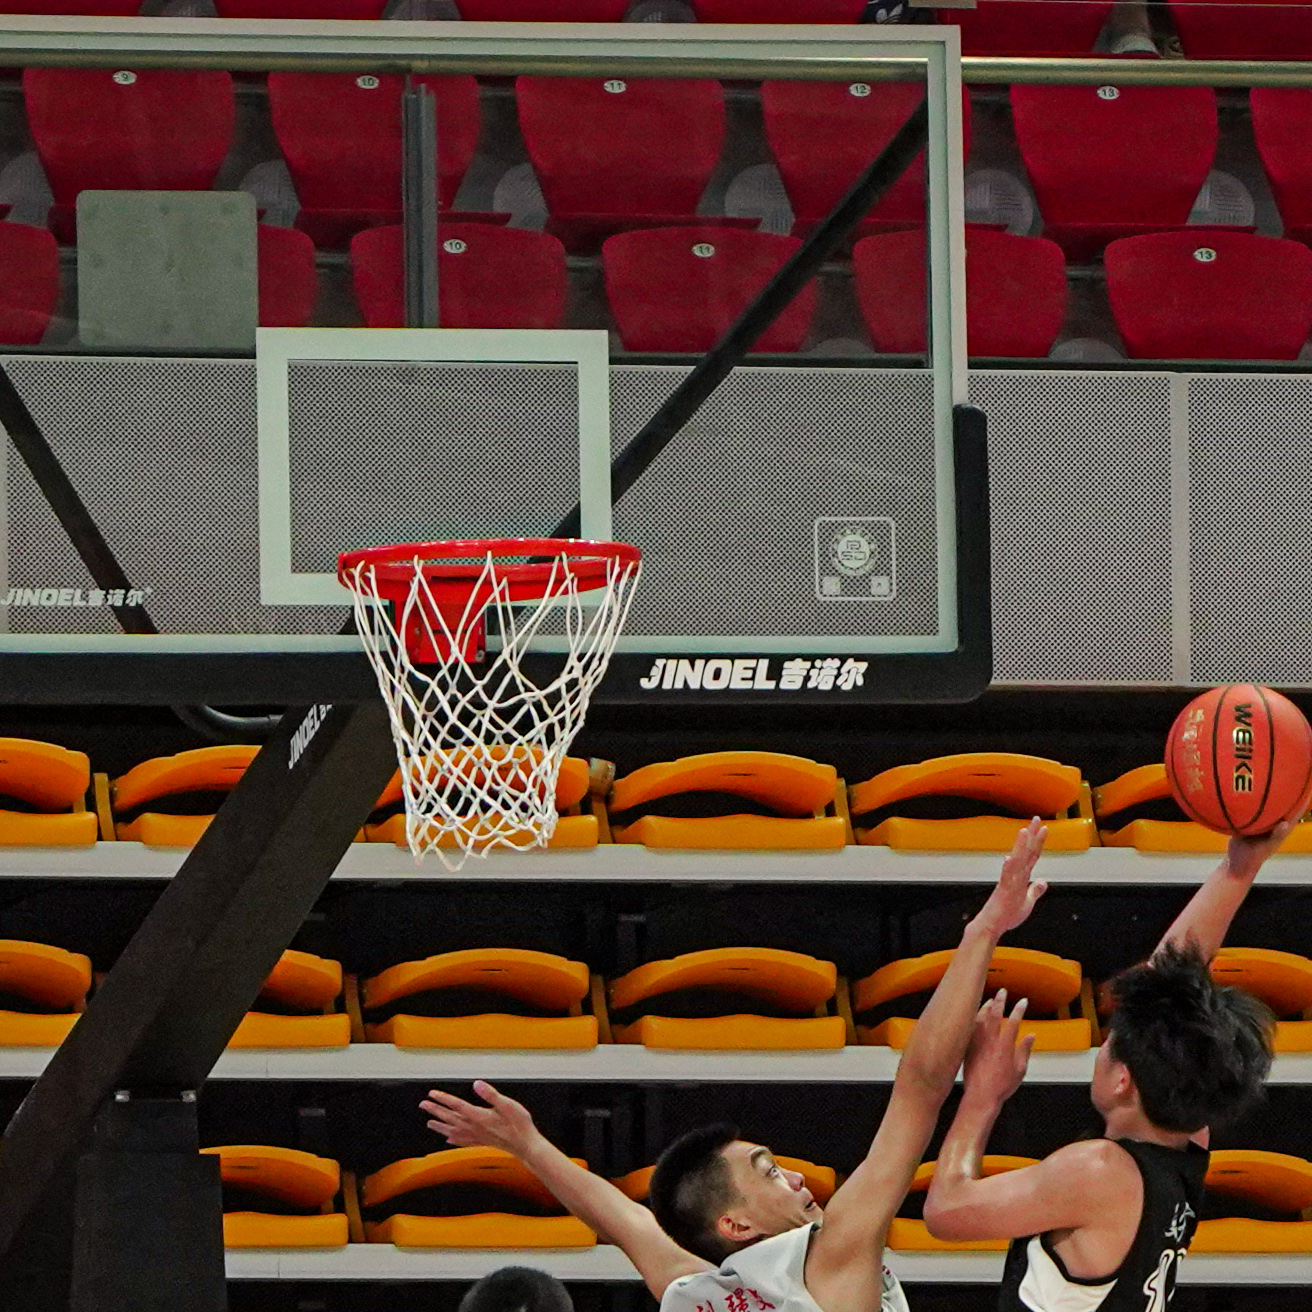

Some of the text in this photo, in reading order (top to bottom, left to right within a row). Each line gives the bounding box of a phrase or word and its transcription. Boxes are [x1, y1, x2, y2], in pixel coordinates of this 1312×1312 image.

[0, 588, 87, 606] JINOEL
[640, 658, 869, 690] JINOEL 吉诺尔
